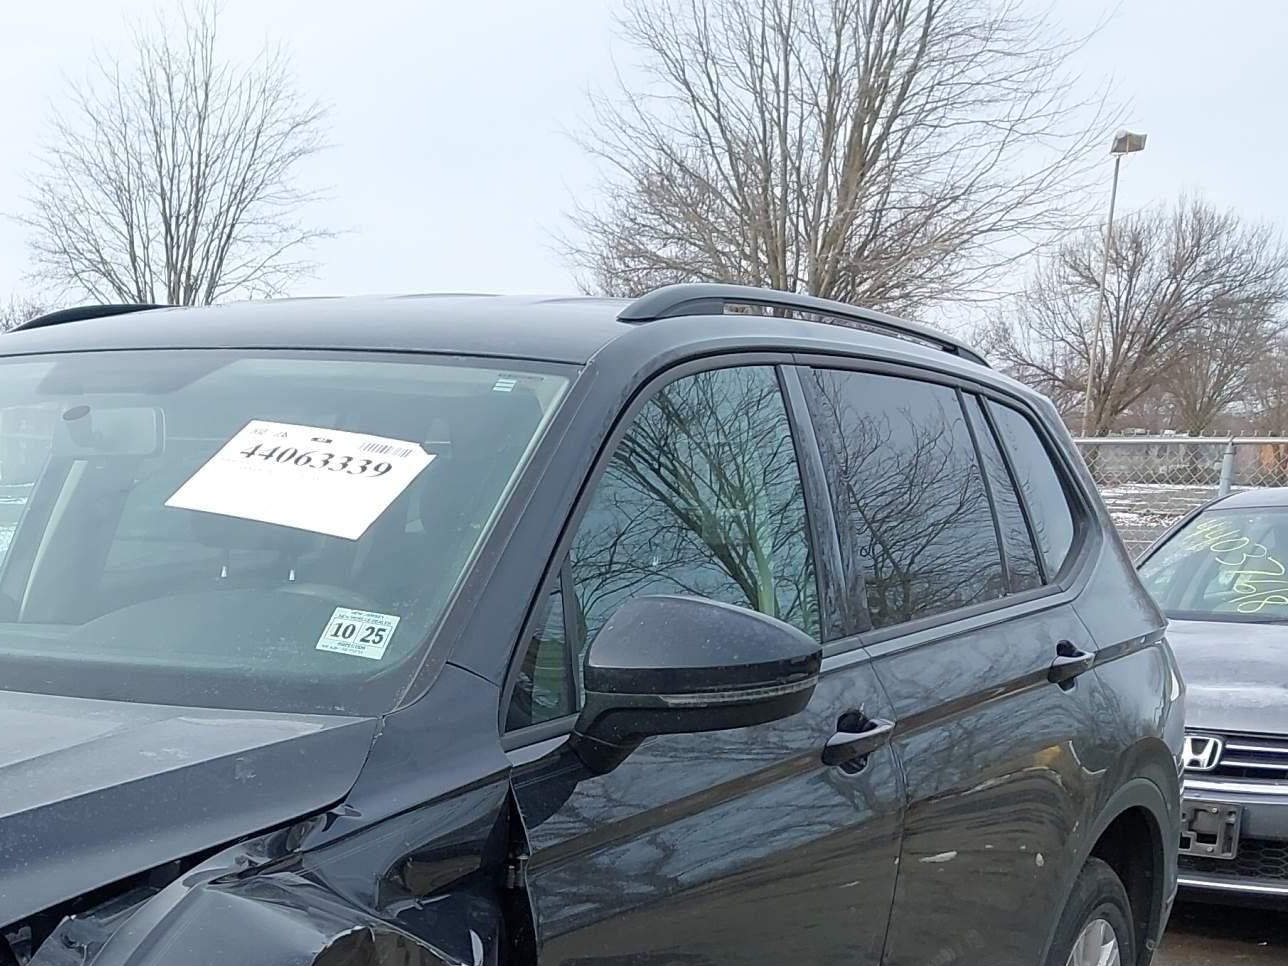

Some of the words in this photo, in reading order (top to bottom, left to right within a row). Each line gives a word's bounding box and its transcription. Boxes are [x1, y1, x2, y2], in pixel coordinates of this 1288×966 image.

[240, 443, 393, 478] 44063339
[330, 622, 356, 640] 10
[359, 625, 387, 645] 25
